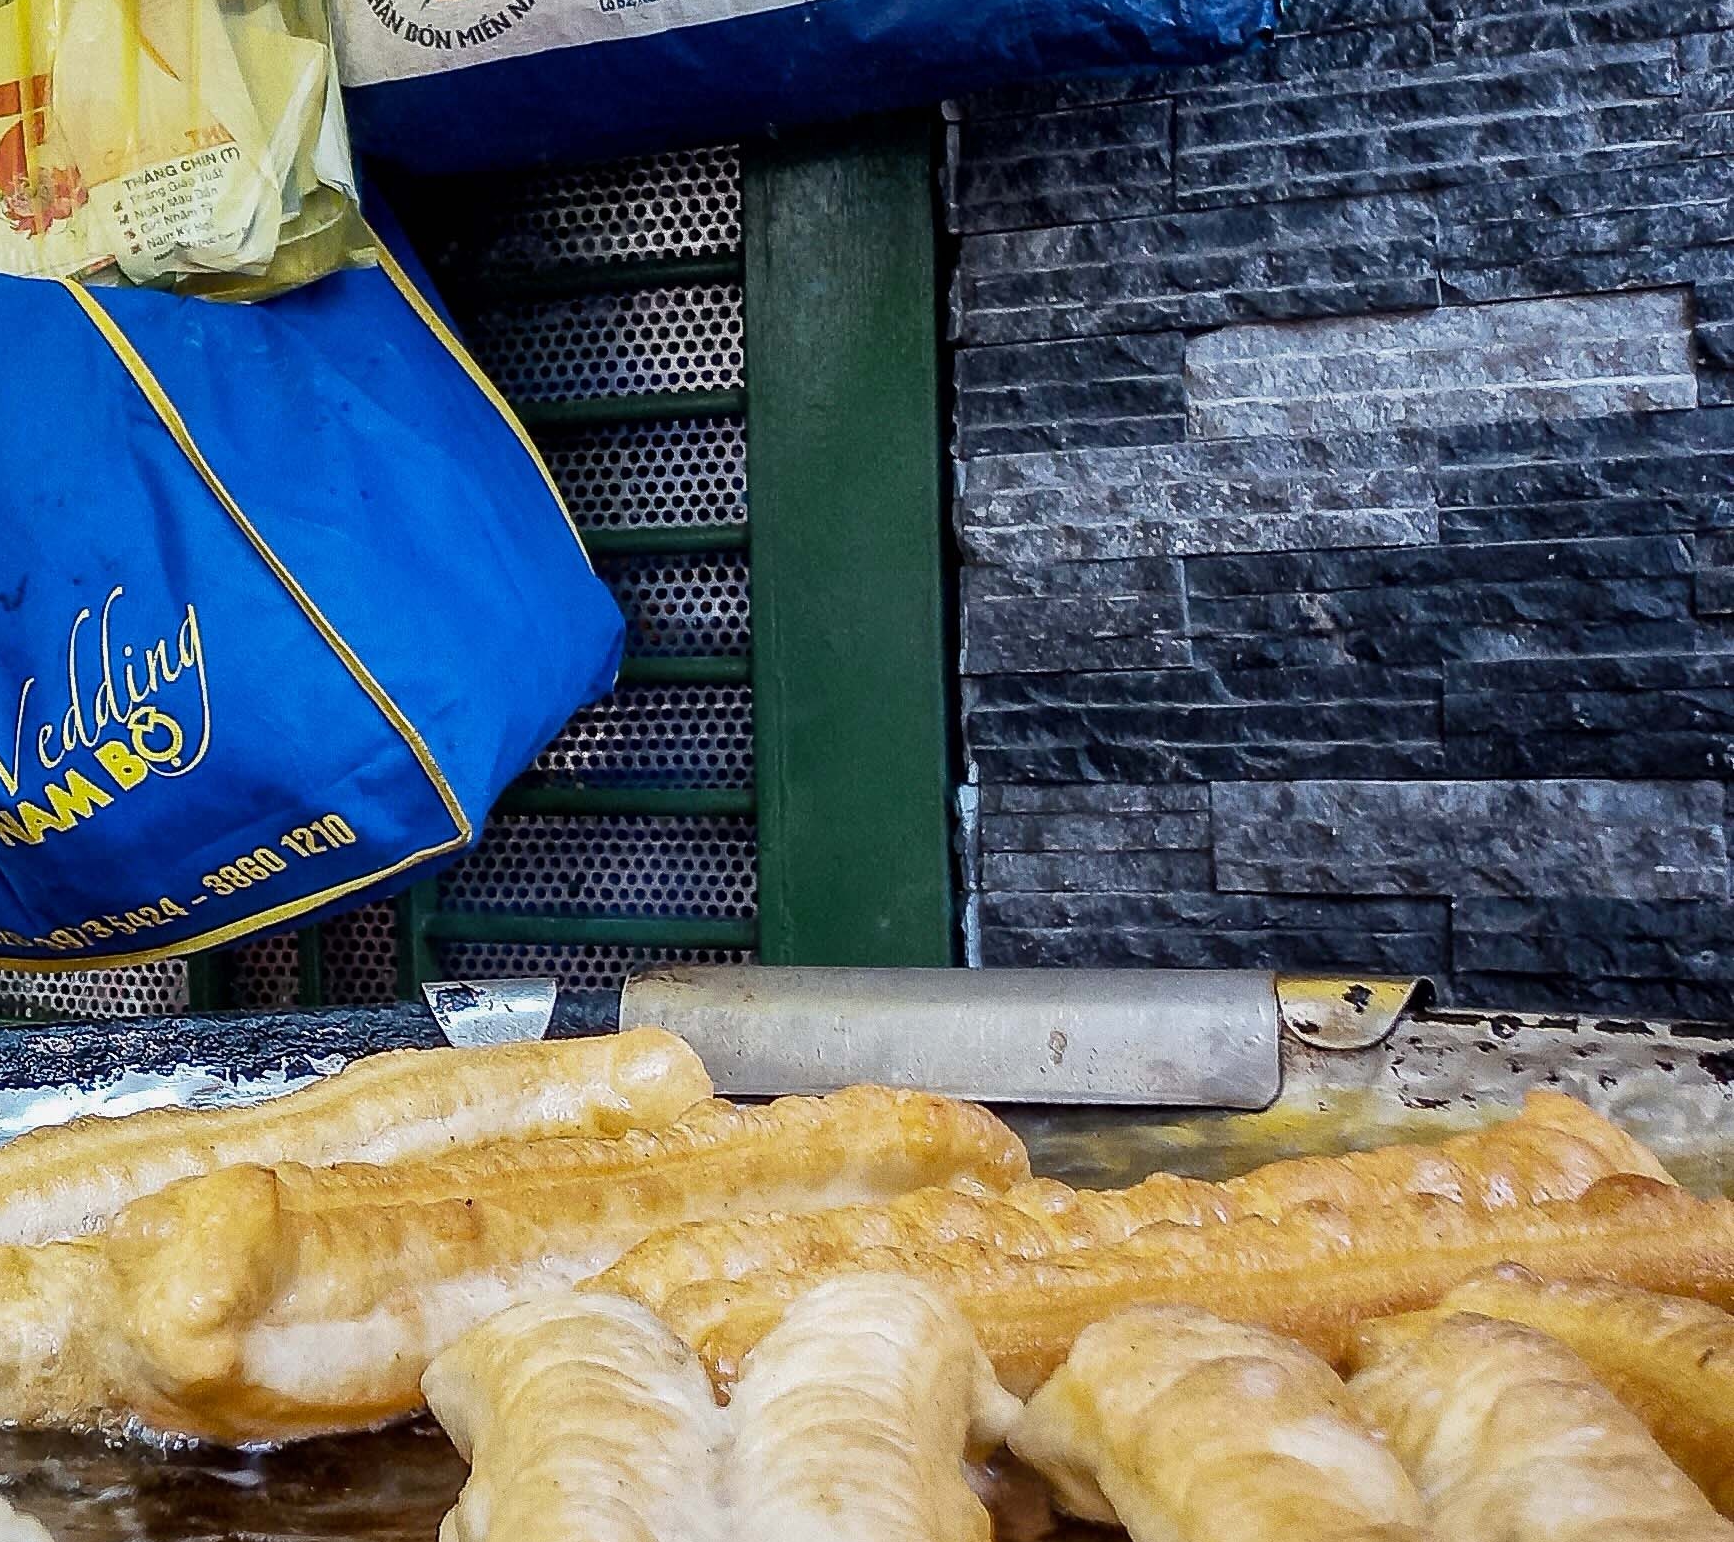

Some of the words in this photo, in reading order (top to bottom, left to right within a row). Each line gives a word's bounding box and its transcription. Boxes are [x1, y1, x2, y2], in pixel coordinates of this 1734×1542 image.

[402, 21, 452, 50] BÓN
[455, 10, 512, 49] MIỀN
[93, 705, 184, 792] BỘ
[202, 847, 288, 896] 3860
[281, 813, 358, 858] 1210
